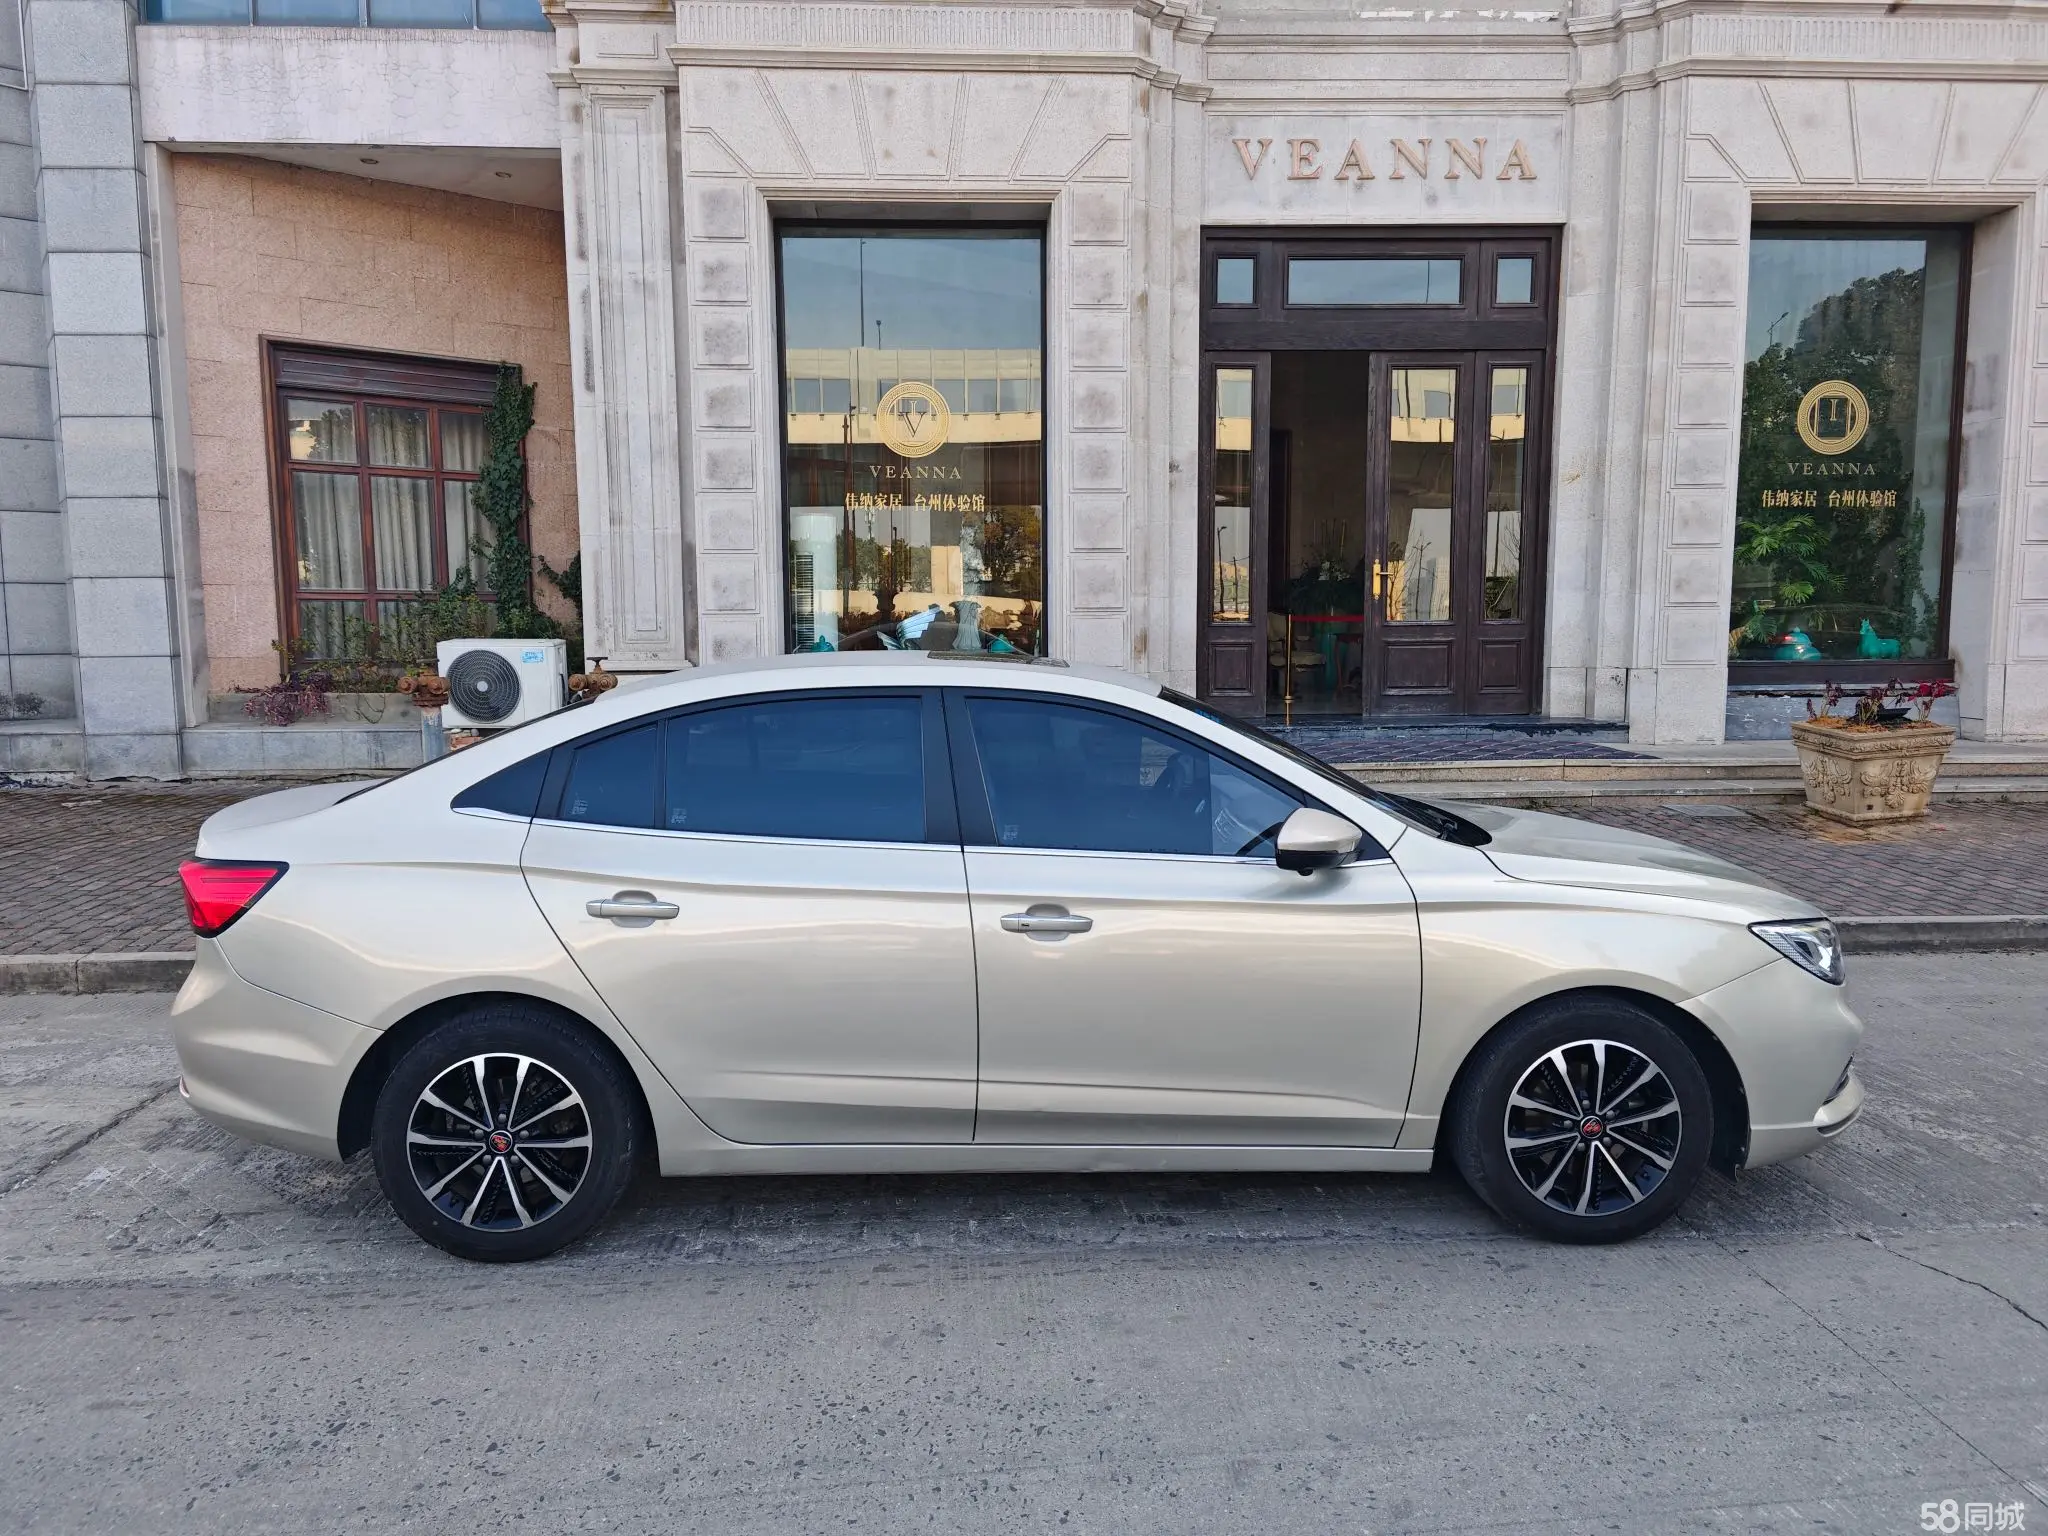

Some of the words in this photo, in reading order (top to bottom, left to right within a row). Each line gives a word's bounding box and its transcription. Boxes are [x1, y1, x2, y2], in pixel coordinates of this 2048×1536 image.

[1232, 138, 1537, 181] VEANNA
[869, 465, 962, 480] VEANNA
[1787, 462, 1876, 476] VEANNA
[845, 493, 903, 511] 伟纳家居
[914, 494, 985, 513] 台州体验馆
[1762, 490, 1817, 508] 伟纳家居
[1828, 490, 1897, 508] 台州体验馆
